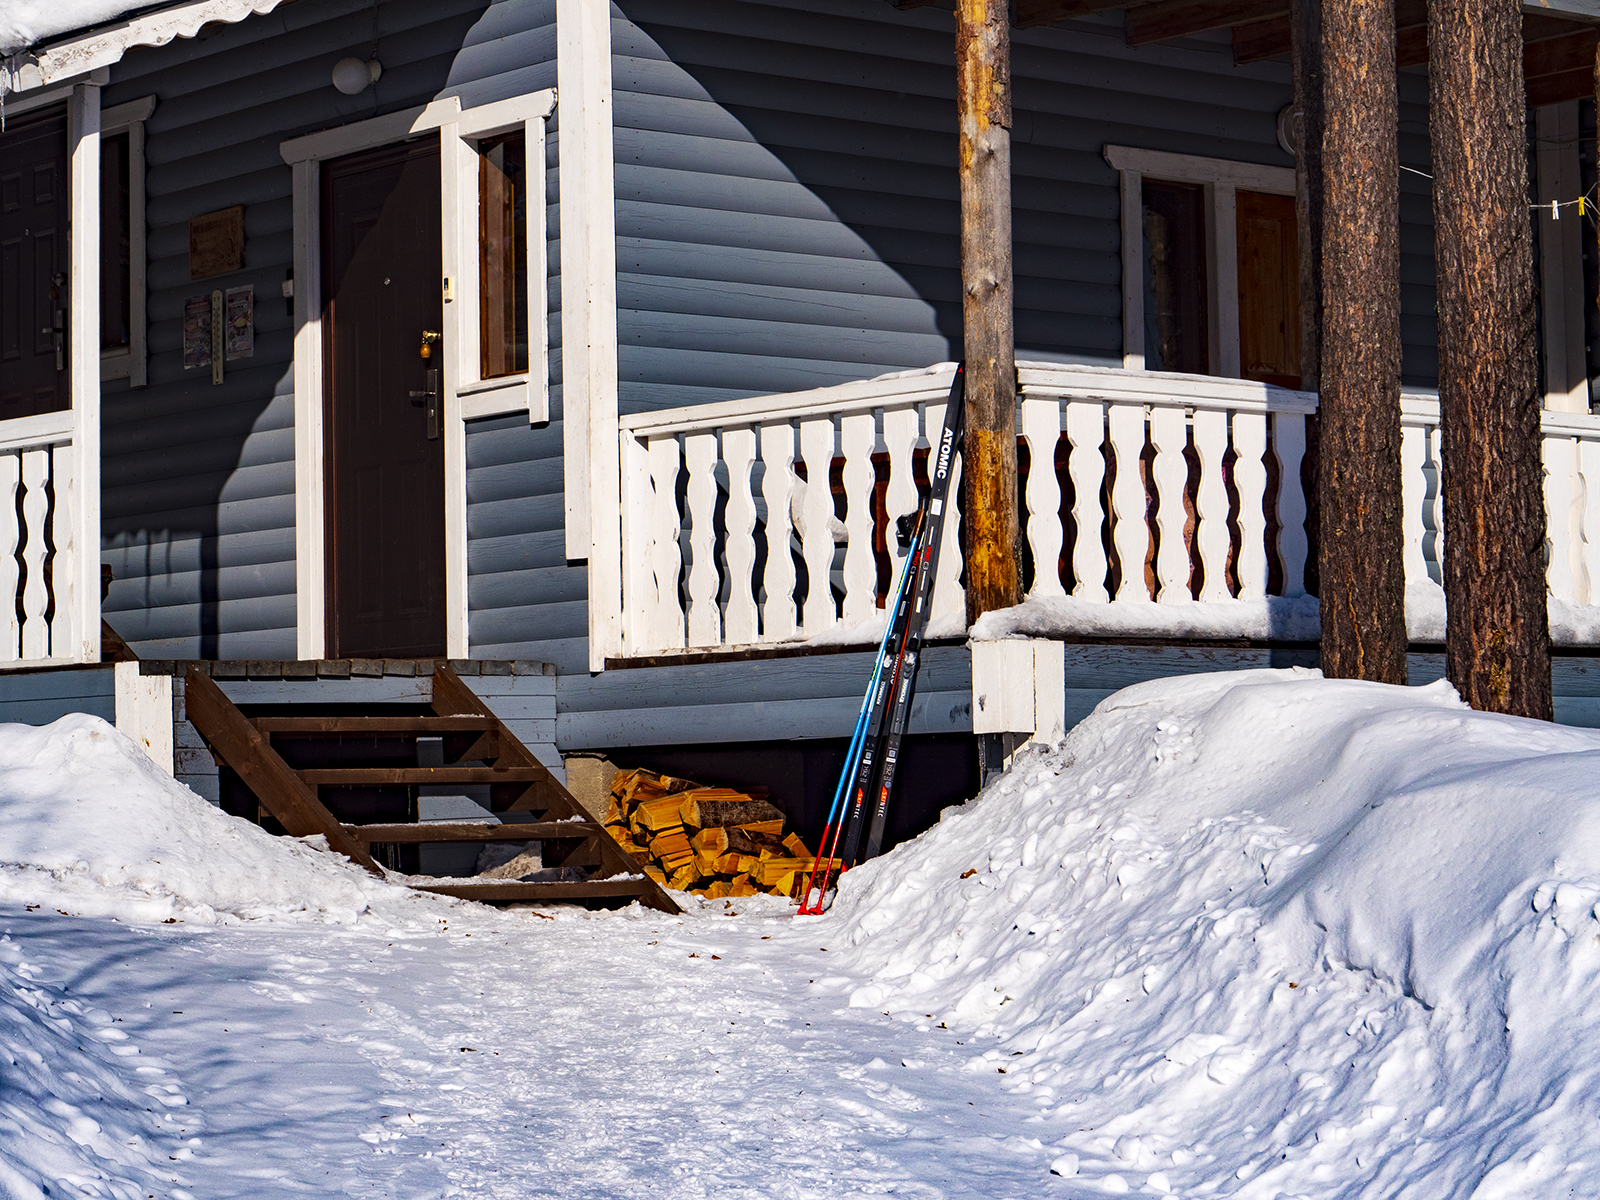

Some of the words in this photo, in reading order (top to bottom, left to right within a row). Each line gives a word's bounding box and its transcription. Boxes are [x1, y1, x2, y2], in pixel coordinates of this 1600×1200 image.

[937, 427, 954, 479] ATOMIC
[912, 551, 920, 565] PRO
[924, 546, 932, 561] PRO
[854, 793, 864, 819] SKINTEC
[877, 791, 888, 817] SKINTEC
